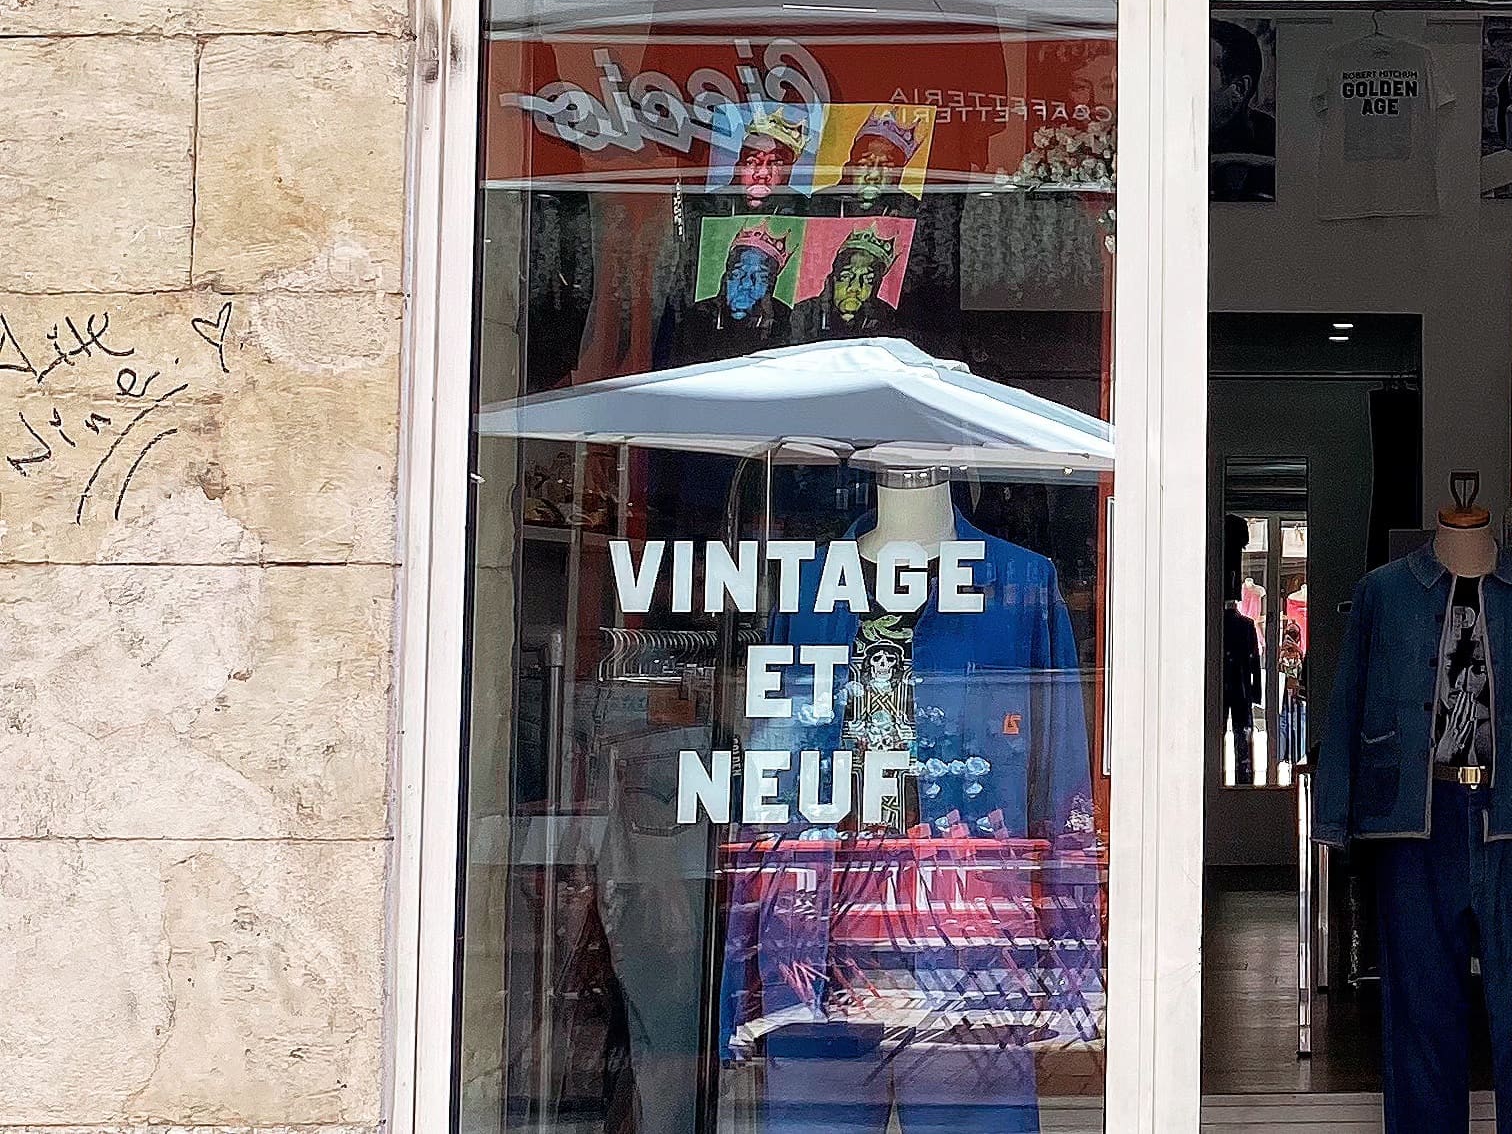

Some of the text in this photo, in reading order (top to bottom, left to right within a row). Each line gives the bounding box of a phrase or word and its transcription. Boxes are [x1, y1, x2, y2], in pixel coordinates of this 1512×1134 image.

[1342, 81, 1417, 98] GOLDEN
[1362, 98, 1398, 116] AGE
[608, 540, 986, 613] VINTAGE
[745, 644, 848, 718] ET
[676, 751, 913, 823] NEUF
